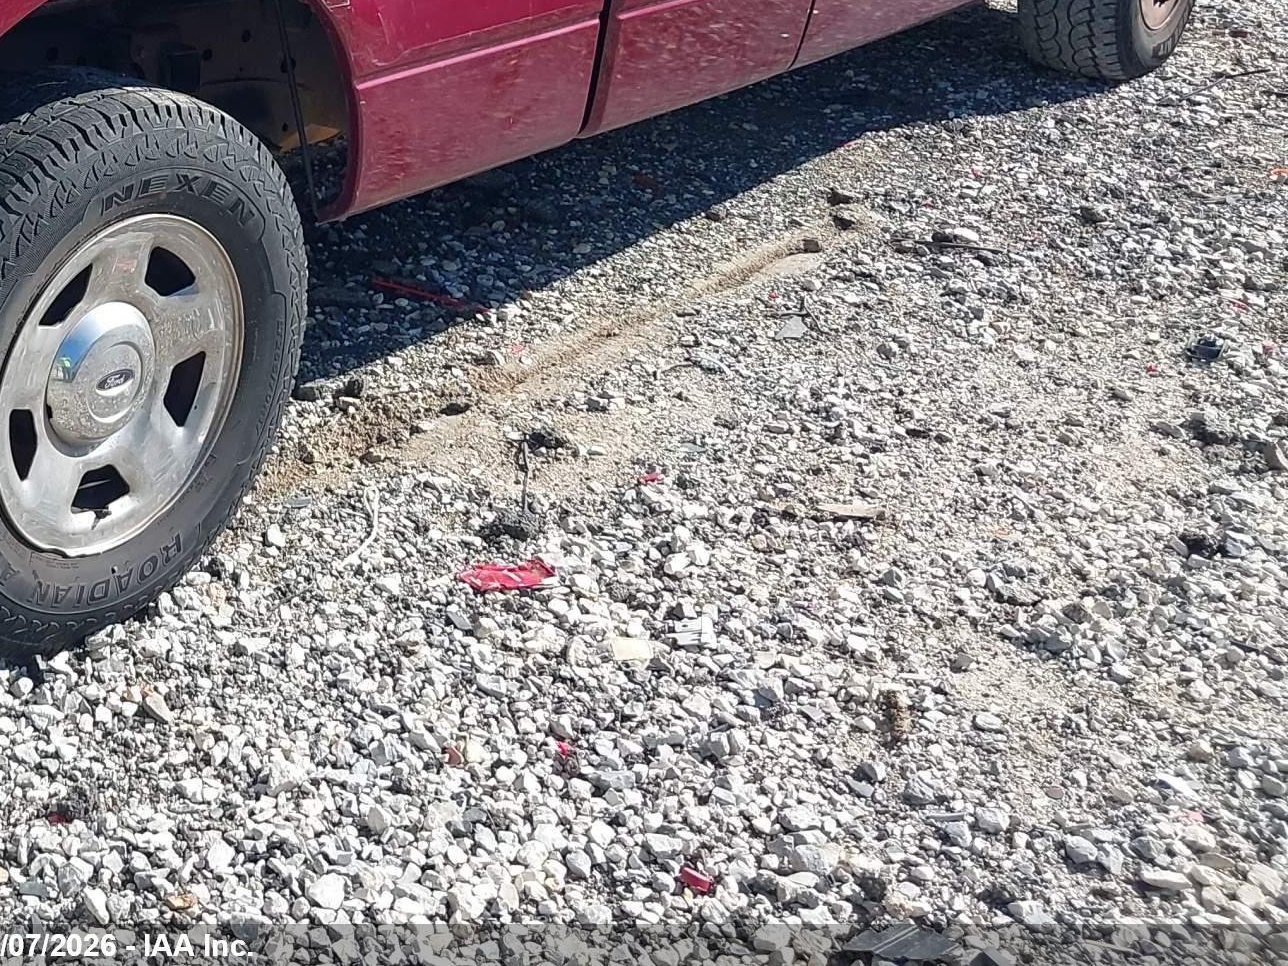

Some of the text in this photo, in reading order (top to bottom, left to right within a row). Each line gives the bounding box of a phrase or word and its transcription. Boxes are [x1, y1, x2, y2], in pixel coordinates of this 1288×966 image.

[101, 172, 256, 228] NEXEN
[104, 373, 127, 389] Ford
[27, 533, 182, 607] ROADIAN
